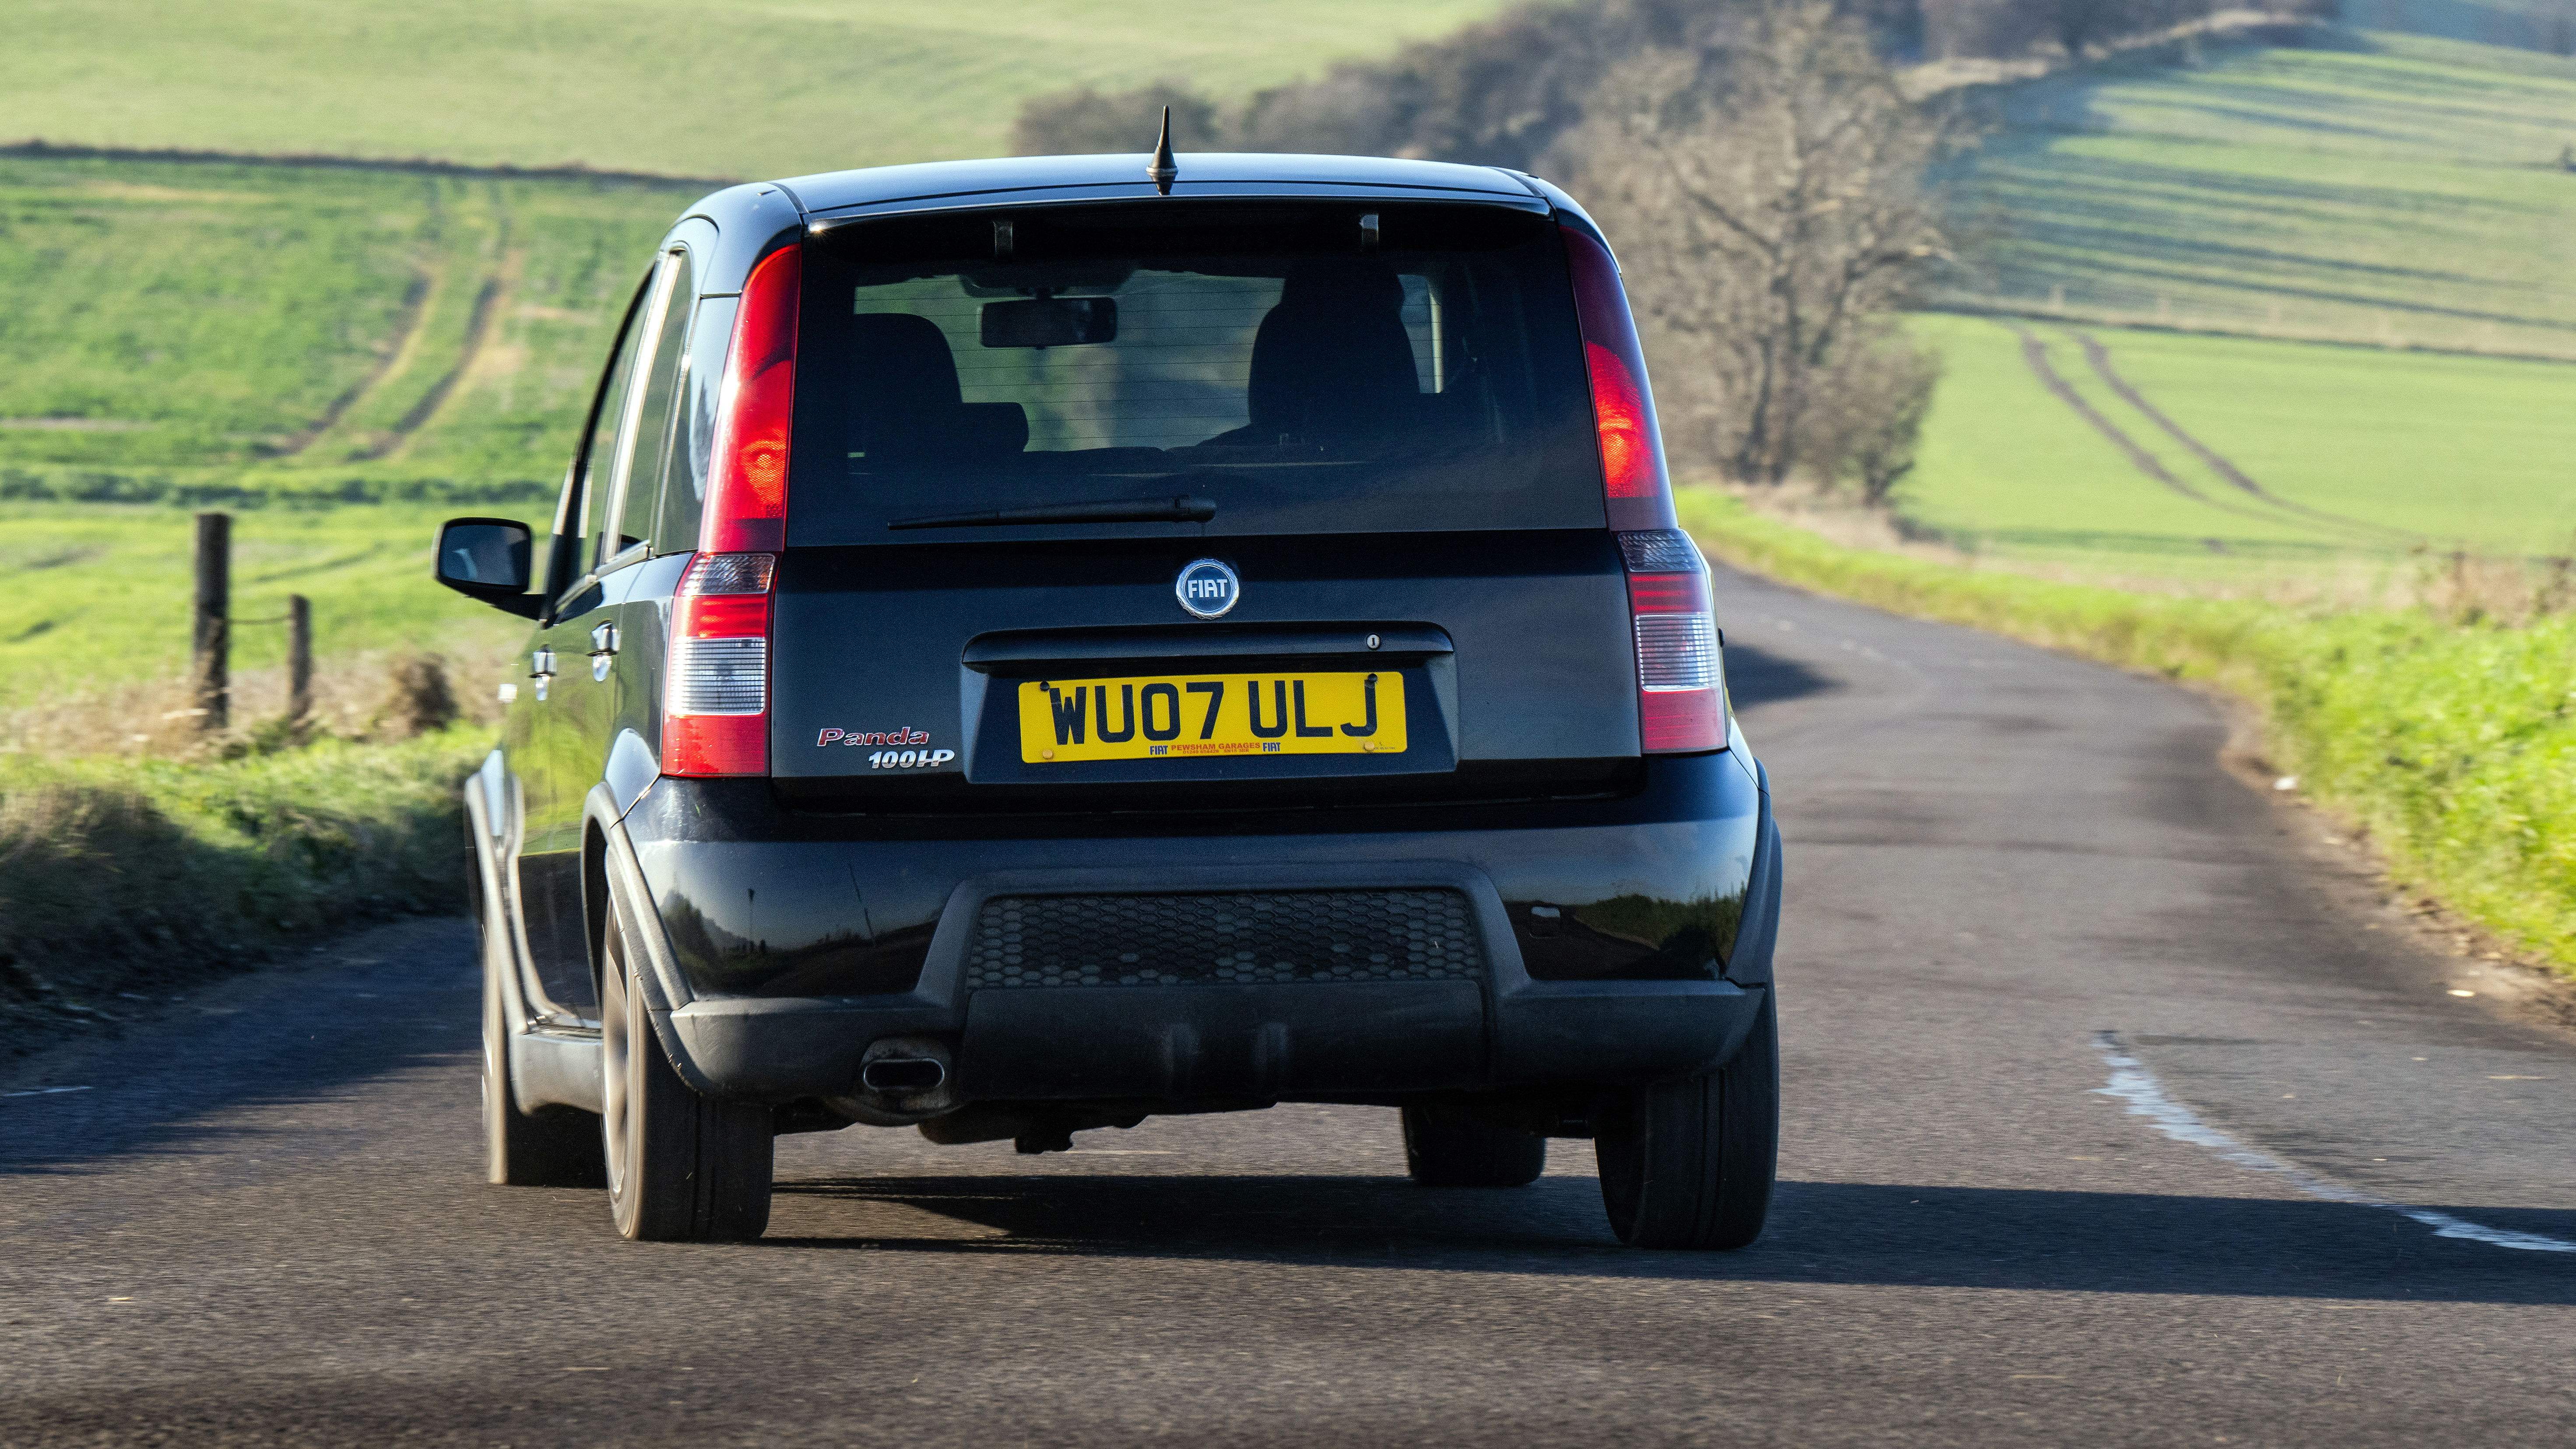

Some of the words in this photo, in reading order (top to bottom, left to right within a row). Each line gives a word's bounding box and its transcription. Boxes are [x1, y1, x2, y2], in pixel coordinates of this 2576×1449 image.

[1188, 579, 1227, 598] FIAT
[1049, 682, 1224, 746] WU07
[1249, 680, 1378, 739] ULJ
[817, 727, 929, 746] Panda
[1149, 745, 1168, 755] FIAT
[1262, 742, 1281, 752] FIAT
[868, 749, 955, 769] 100HP
